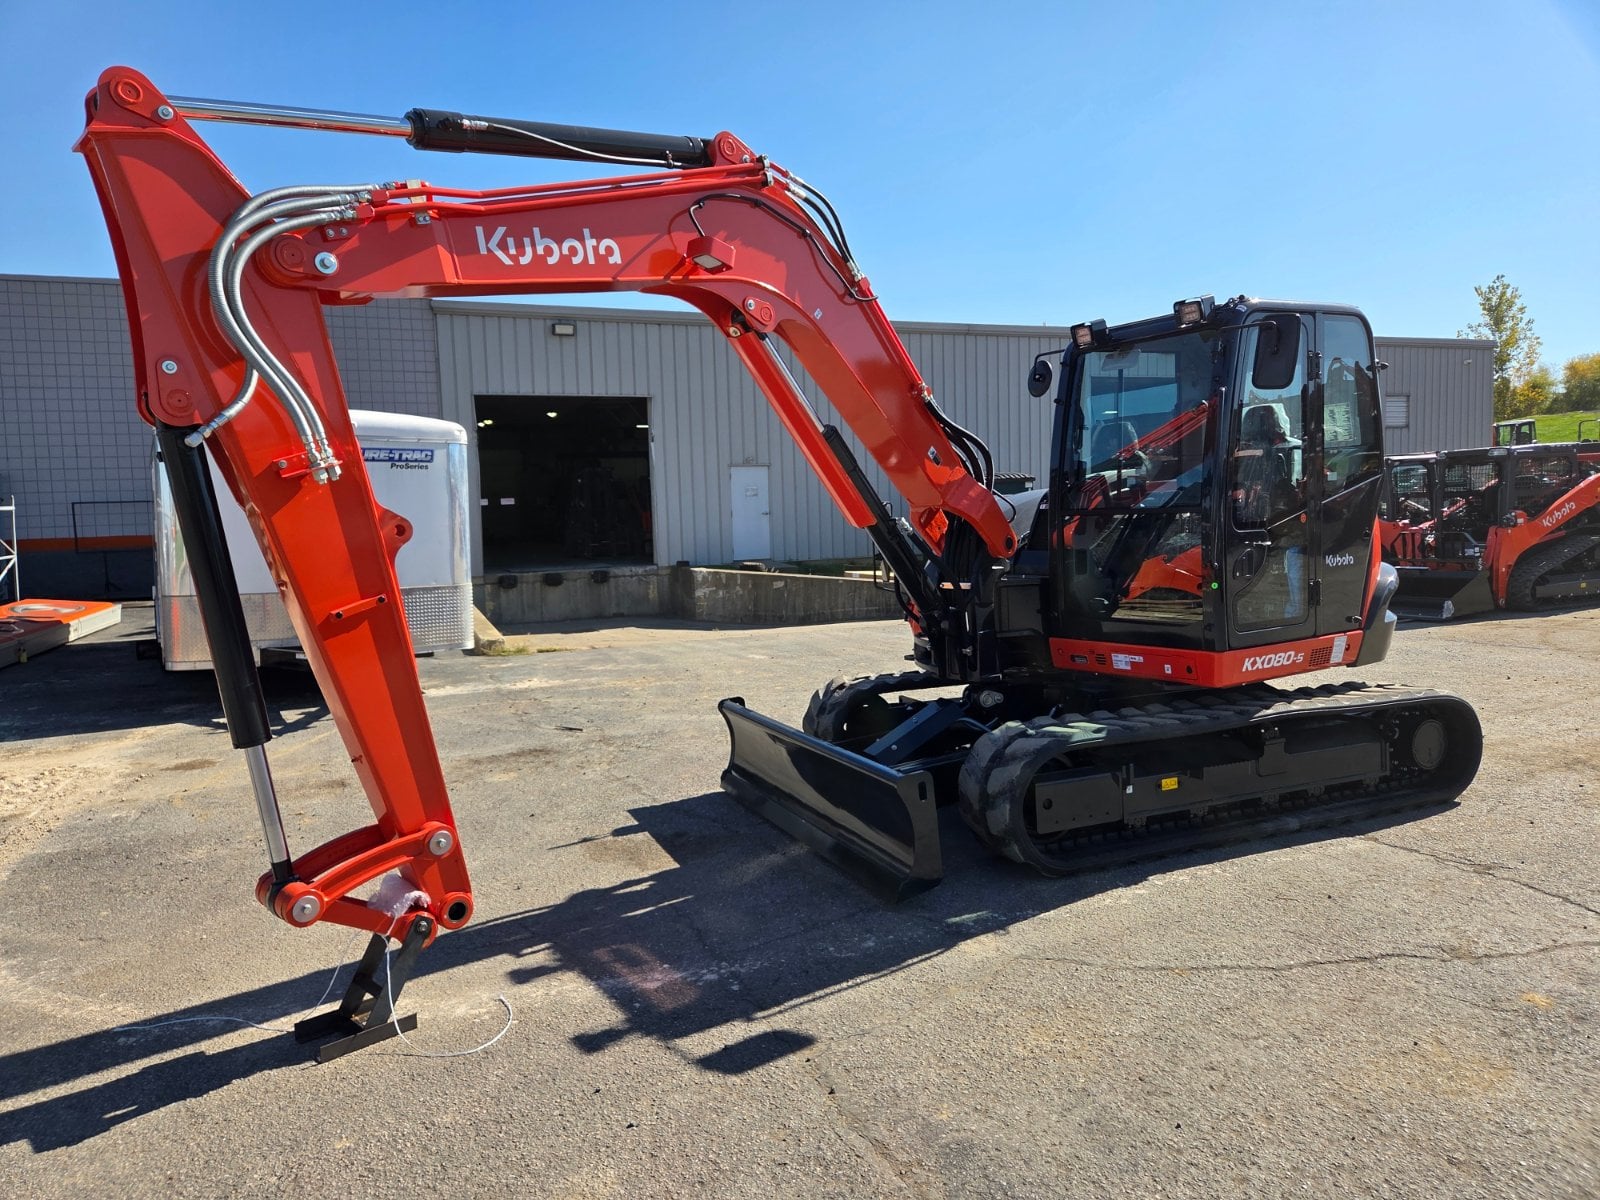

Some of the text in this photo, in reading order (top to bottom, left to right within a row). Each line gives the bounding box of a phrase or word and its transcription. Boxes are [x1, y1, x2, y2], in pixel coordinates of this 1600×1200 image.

[475, 225, 622, 265] Kubota
[364, 449, 432, 461] URE-TRAC
[1542, 501, 1576, 527] Kubota
[1325, 553, 1354, 567] Kubota
